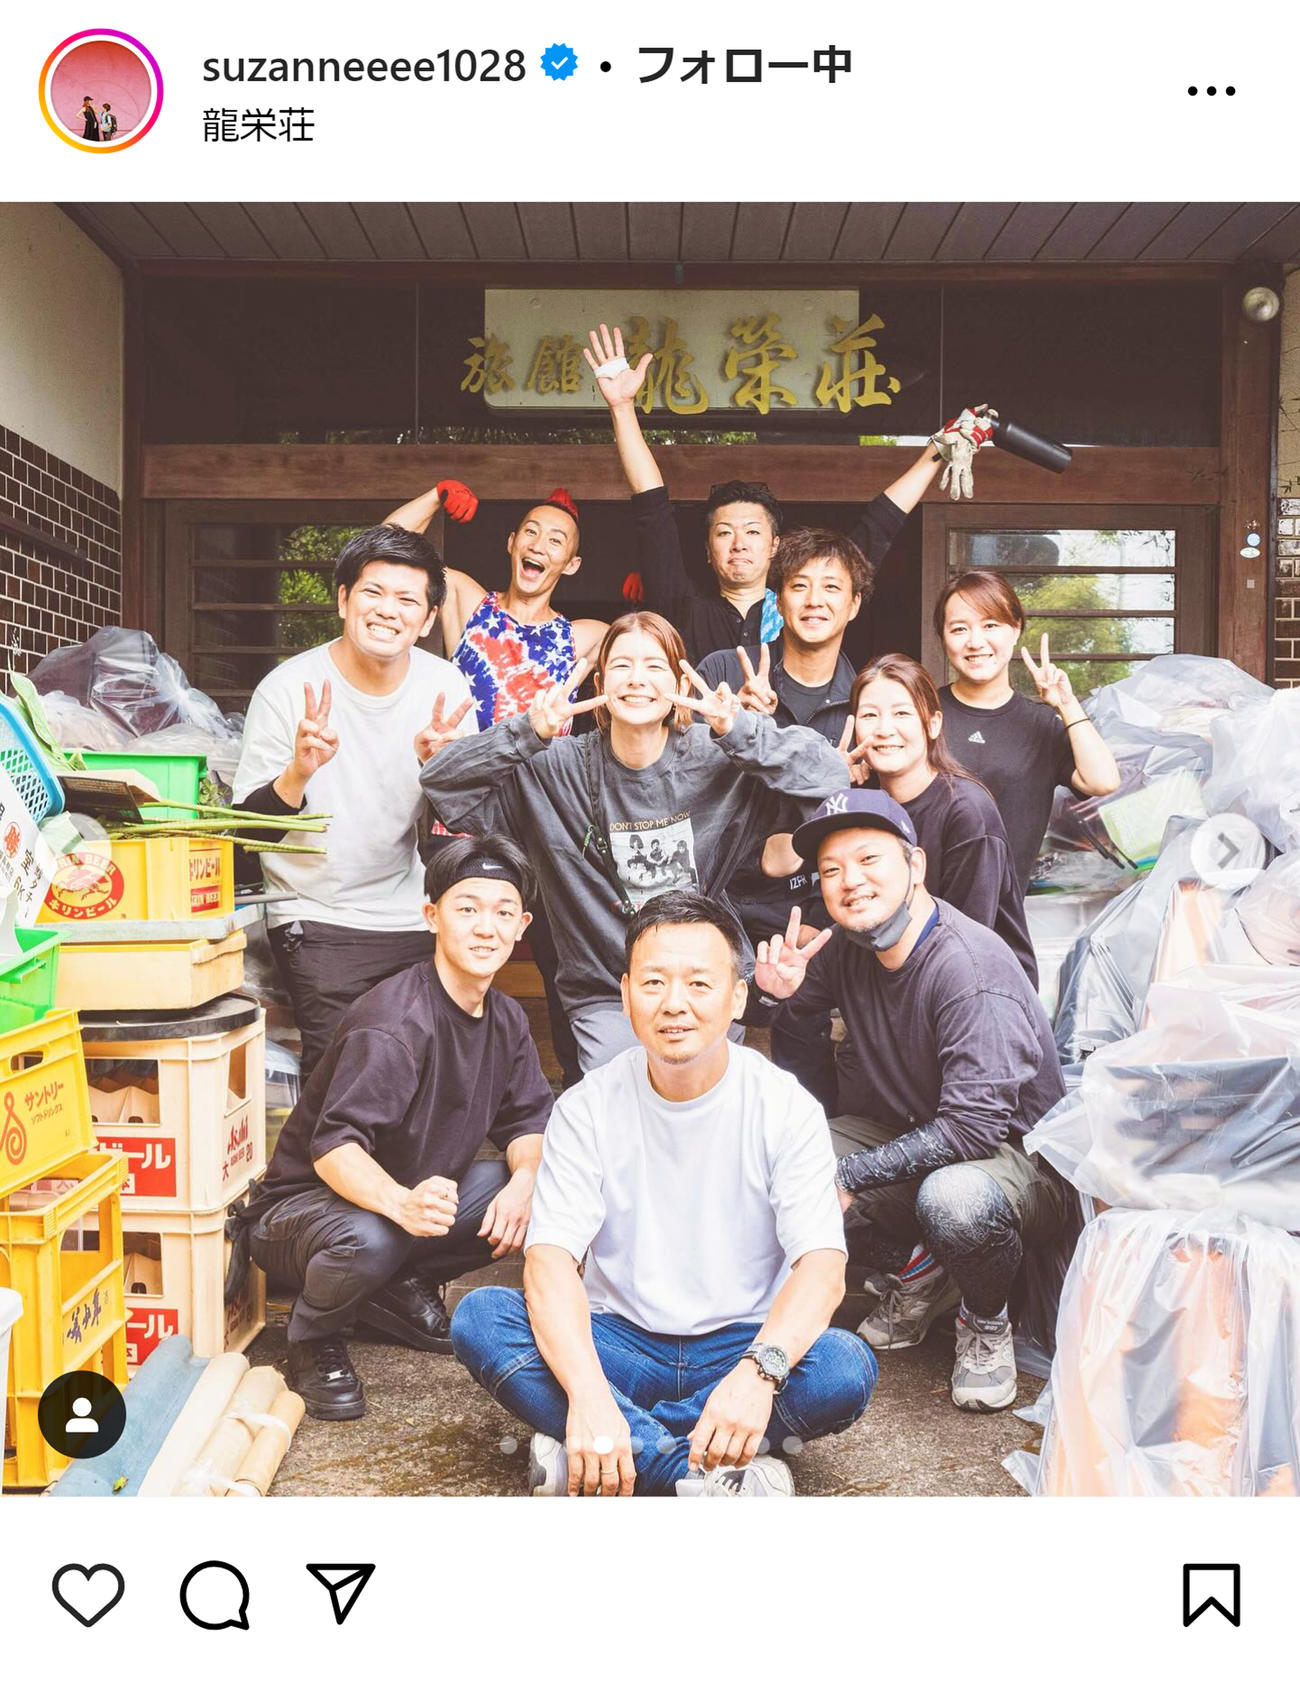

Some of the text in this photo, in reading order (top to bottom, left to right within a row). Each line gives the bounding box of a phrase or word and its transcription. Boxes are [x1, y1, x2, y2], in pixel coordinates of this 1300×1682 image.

[460, 333, 582, 395] 旅館
[634, 819, 655, 831] STOP
[656, 817, 669, 828] ME
[670, 811, 691, 823] NOW
[49, 898, 117, 918] キリンビール
[25, 1081, 64, 1112] サントリー
